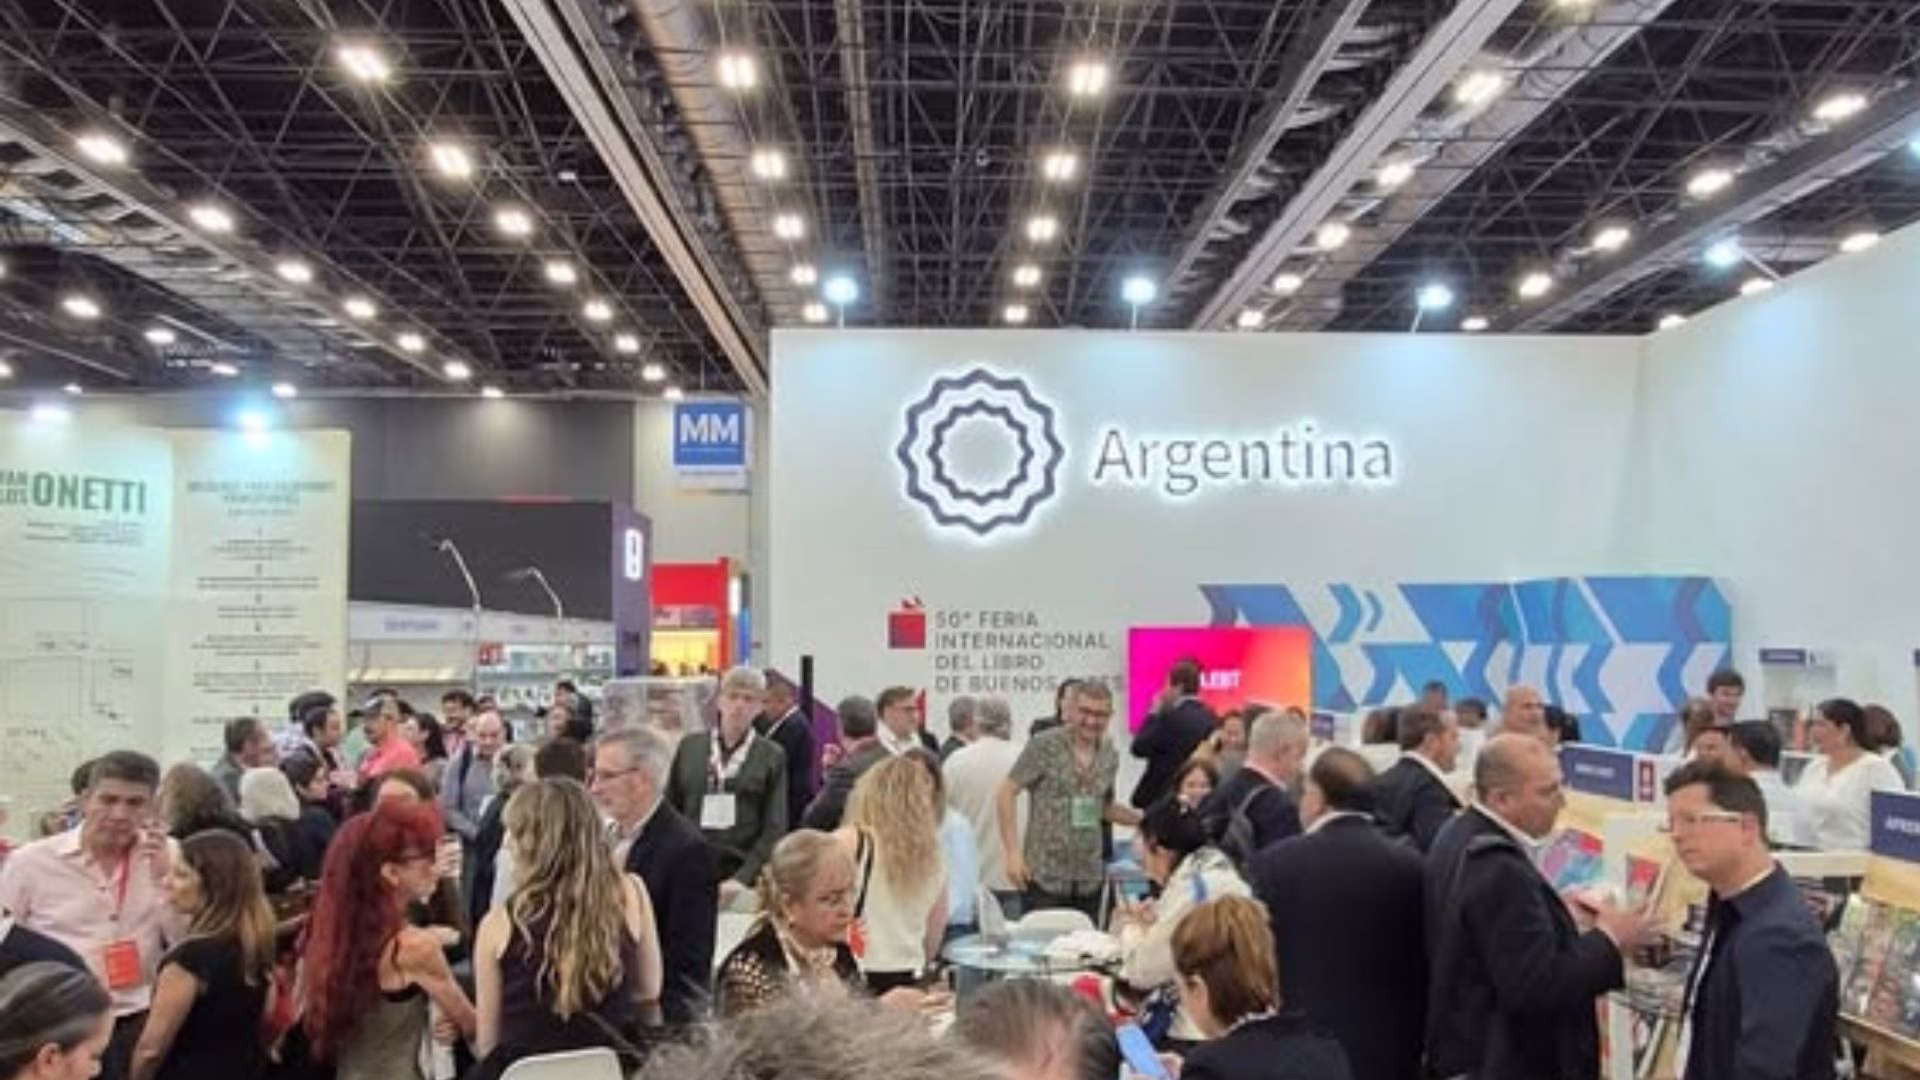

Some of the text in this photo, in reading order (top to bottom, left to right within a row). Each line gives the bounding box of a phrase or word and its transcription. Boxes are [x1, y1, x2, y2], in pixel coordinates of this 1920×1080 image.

[680, 412, 739, 443] MM
[1094, 428, 1391, 495] Argentina
[33, 471, 147, 515] ONETTI
[979, 610, 1039, 628] FERIA
[935, 631, 1110, 650] INTERNACIONAL
[935, 655, 1044, 670] DEL LIBRO
[935, 675, 963, 692] DE
[968, 675, 1057, 692] BUENOS
